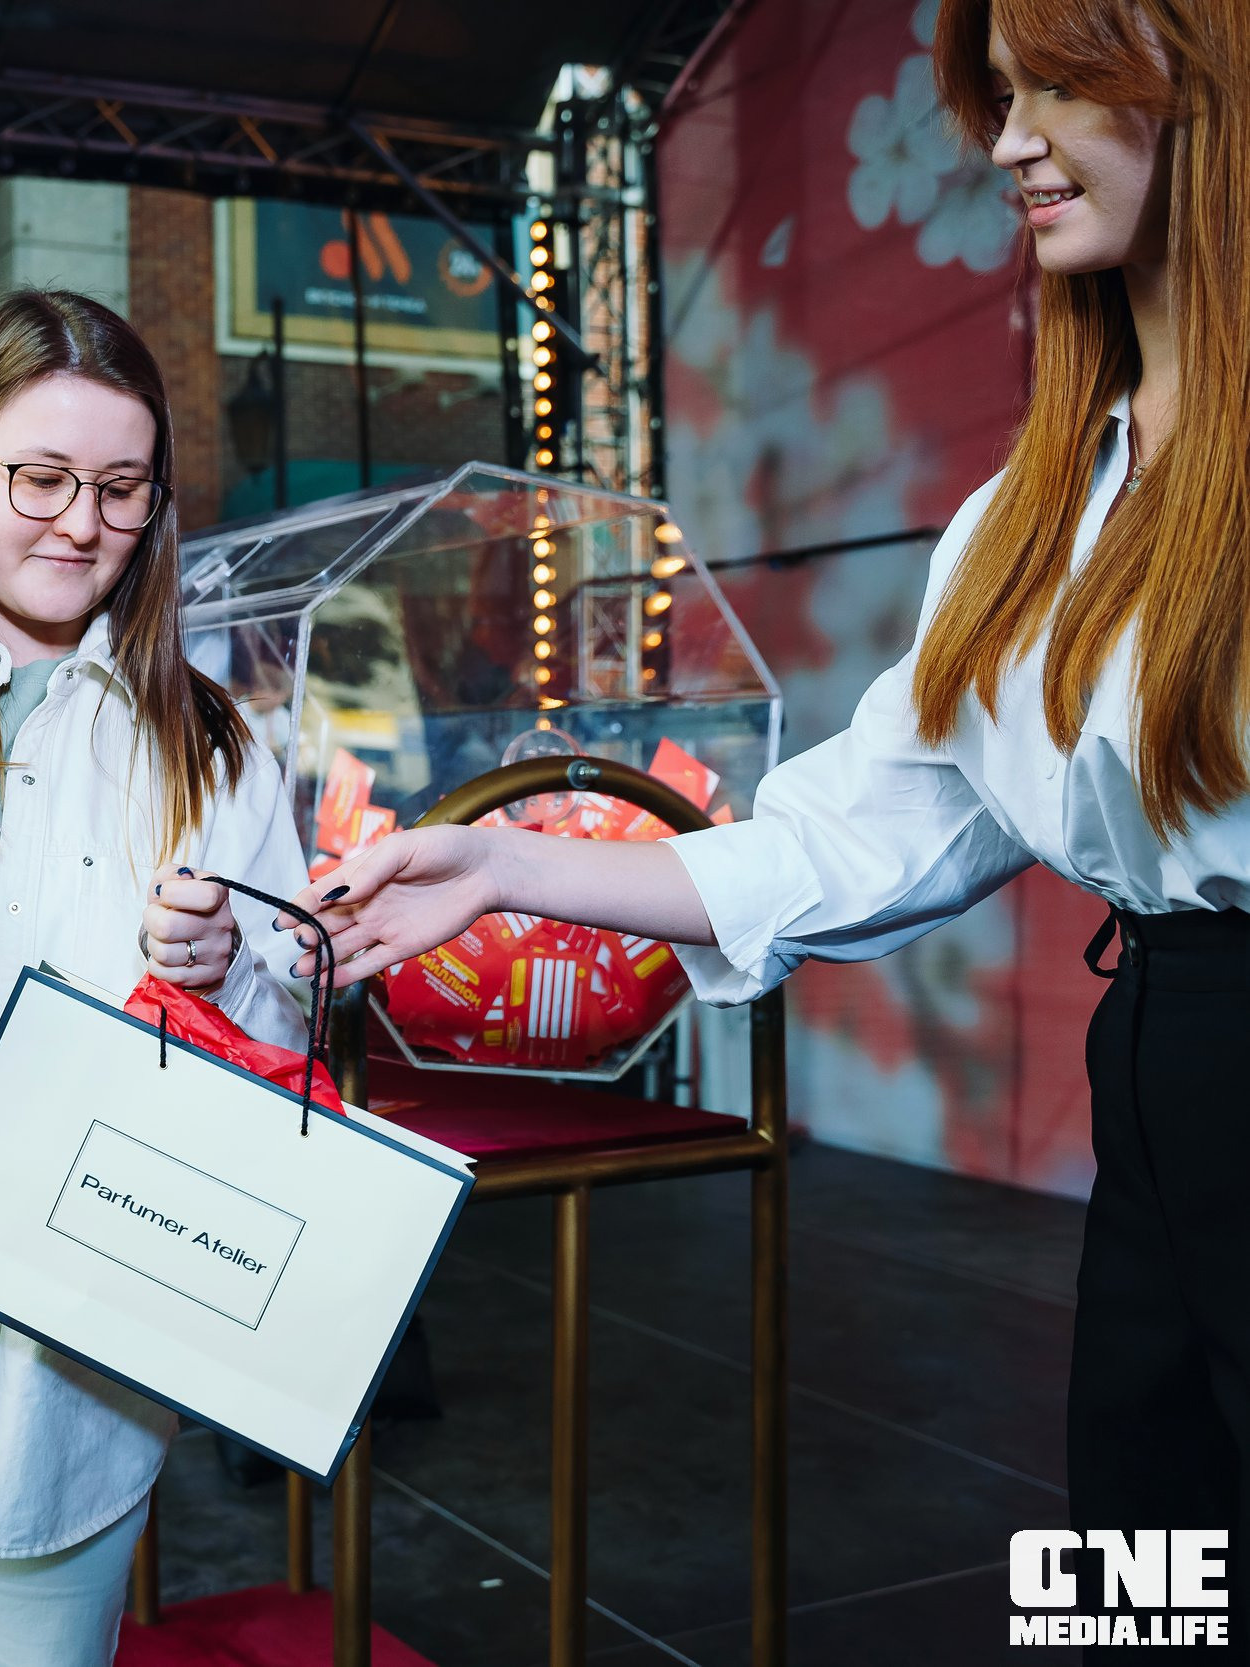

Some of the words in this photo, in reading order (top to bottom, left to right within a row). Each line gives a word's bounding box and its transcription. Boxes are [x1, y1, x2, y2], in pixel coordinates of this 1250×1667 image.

[418, 953, 482, 1007] МИЛЛИОН
[80, 1173, 189, 1236] Parfumer
[191, 1231, 267, 1275] Atelier
